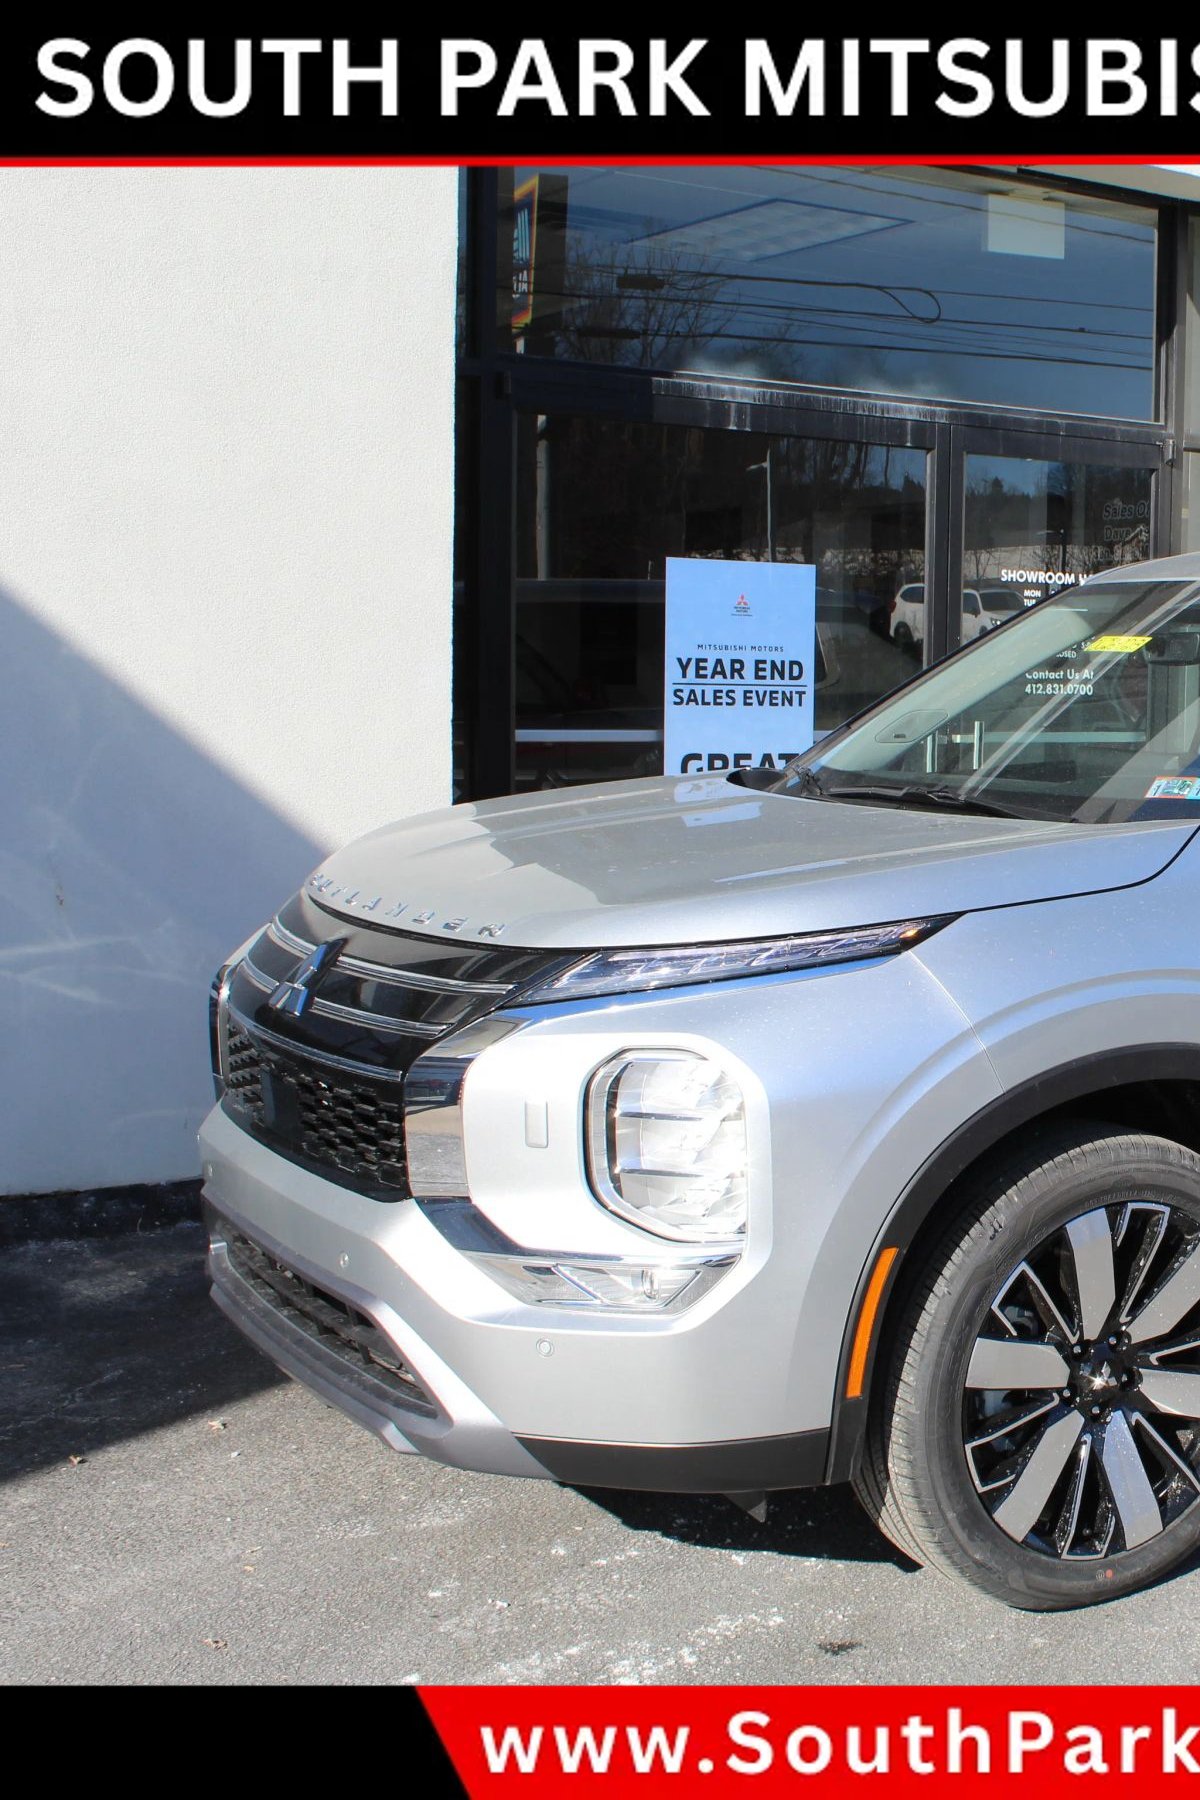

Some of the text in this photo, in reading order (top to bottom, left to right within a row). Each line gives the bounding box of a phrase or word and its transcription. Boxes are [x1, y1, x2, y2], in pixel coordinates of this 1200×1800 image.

[1103, 501, 1135, 520] Sales
[1001, 569, 1075, 585] SHOWROOM
[1023, 589, 1042, 598] MON
[697, 644, 784, 653] MITSUBISHI MOTORS
[676, 657, 804, 681] YEAR END
[1025, 669, 1094, 680] Contact Us At
[1024, 683, 1094, 696] 412.831.0700
[673, 688, 807, 707] SALES EVENT
